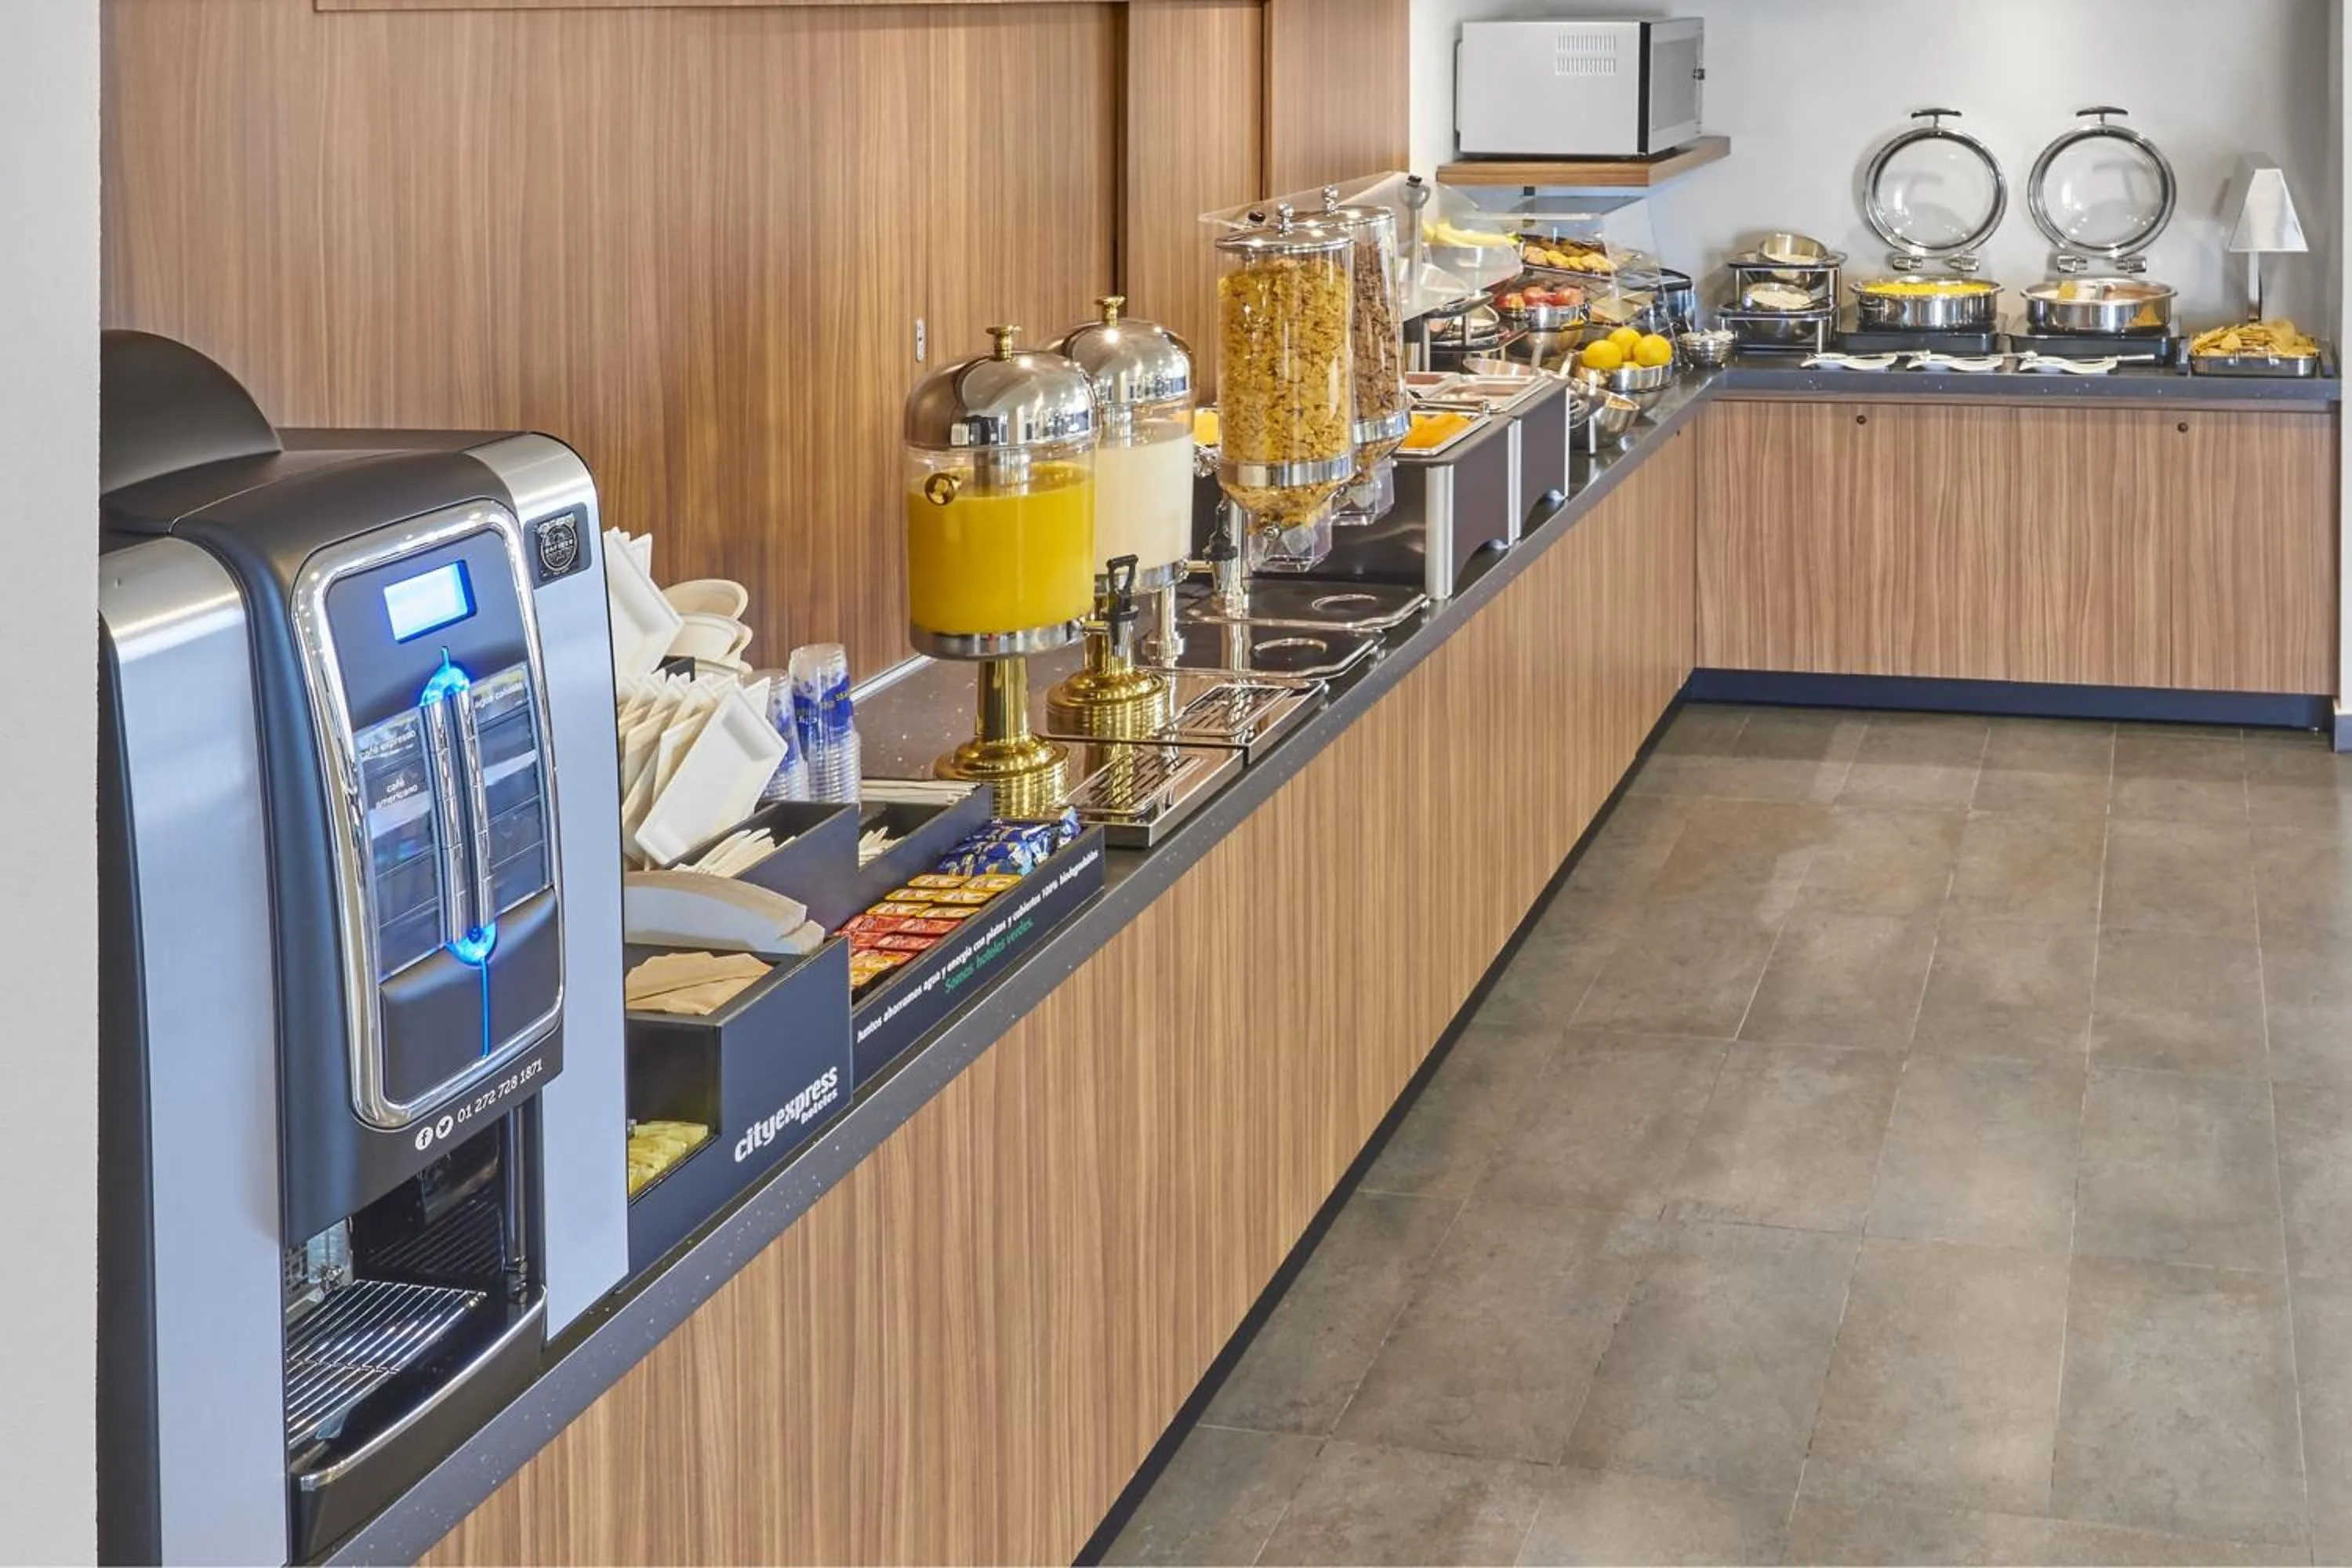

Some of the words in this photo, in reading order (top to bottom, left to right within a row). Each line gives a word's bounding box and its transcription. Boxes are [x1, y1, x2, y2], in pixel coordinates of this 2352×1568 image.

[857, 1016, 883, 1044] Juntos
[884, 985, 923, 1022] ahorramos
[924, 971, 941, 991] agua
[941, 966, 946, 979] y
[973, 936, 985, 952] con
[1007, 915, 1012, 928] y
[1013, 893, 1041, 921] cubiertos
[1042, 879, 1058, 899] 100%
[457, 1103, 473, 1123] 01
[474, 1089, 496, 1113] 272
[498, 1075, 519, 1098] 728
[520, 1058, 543, 1085] 1871
[800, 1087, 838, 1125] hoteles
